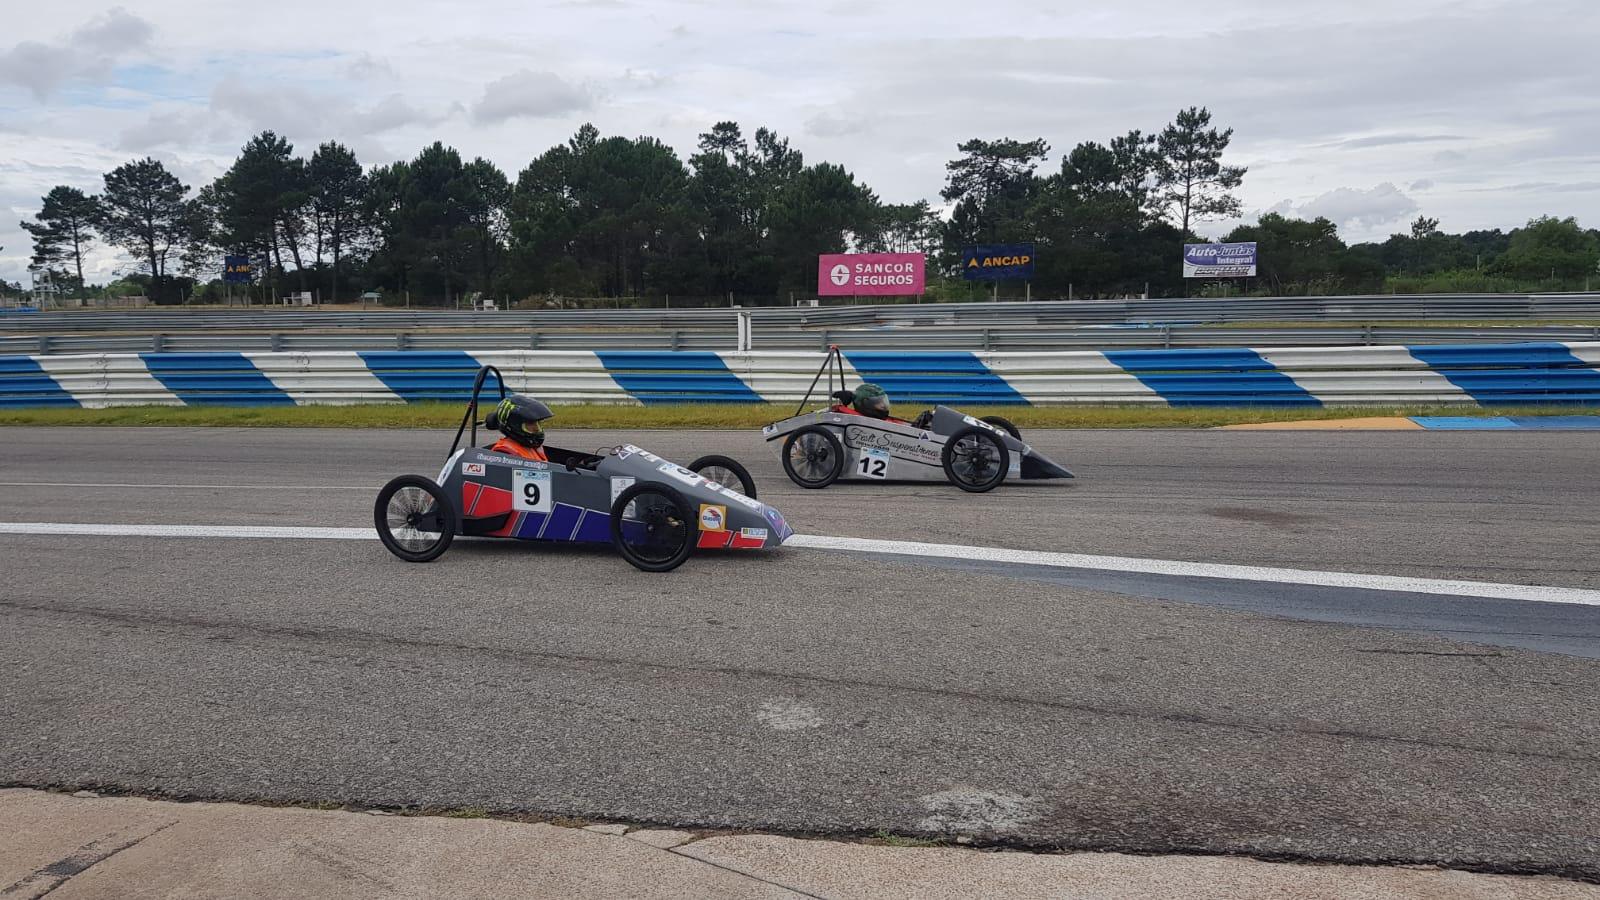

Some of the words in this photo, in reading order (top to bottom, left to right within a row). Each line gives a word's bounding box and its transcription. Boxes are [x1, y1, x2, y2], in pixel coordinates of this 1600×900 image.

[983, 255, 1030, 267] ANCAP
[1216, 256, 1253, 265] Integral
[855, 263, 914, 273] SANCOR
[854, 274, 914, 286] SEGUROS
[860, 457, 886, 477] 12
[523, 483, 541, 506] 9
